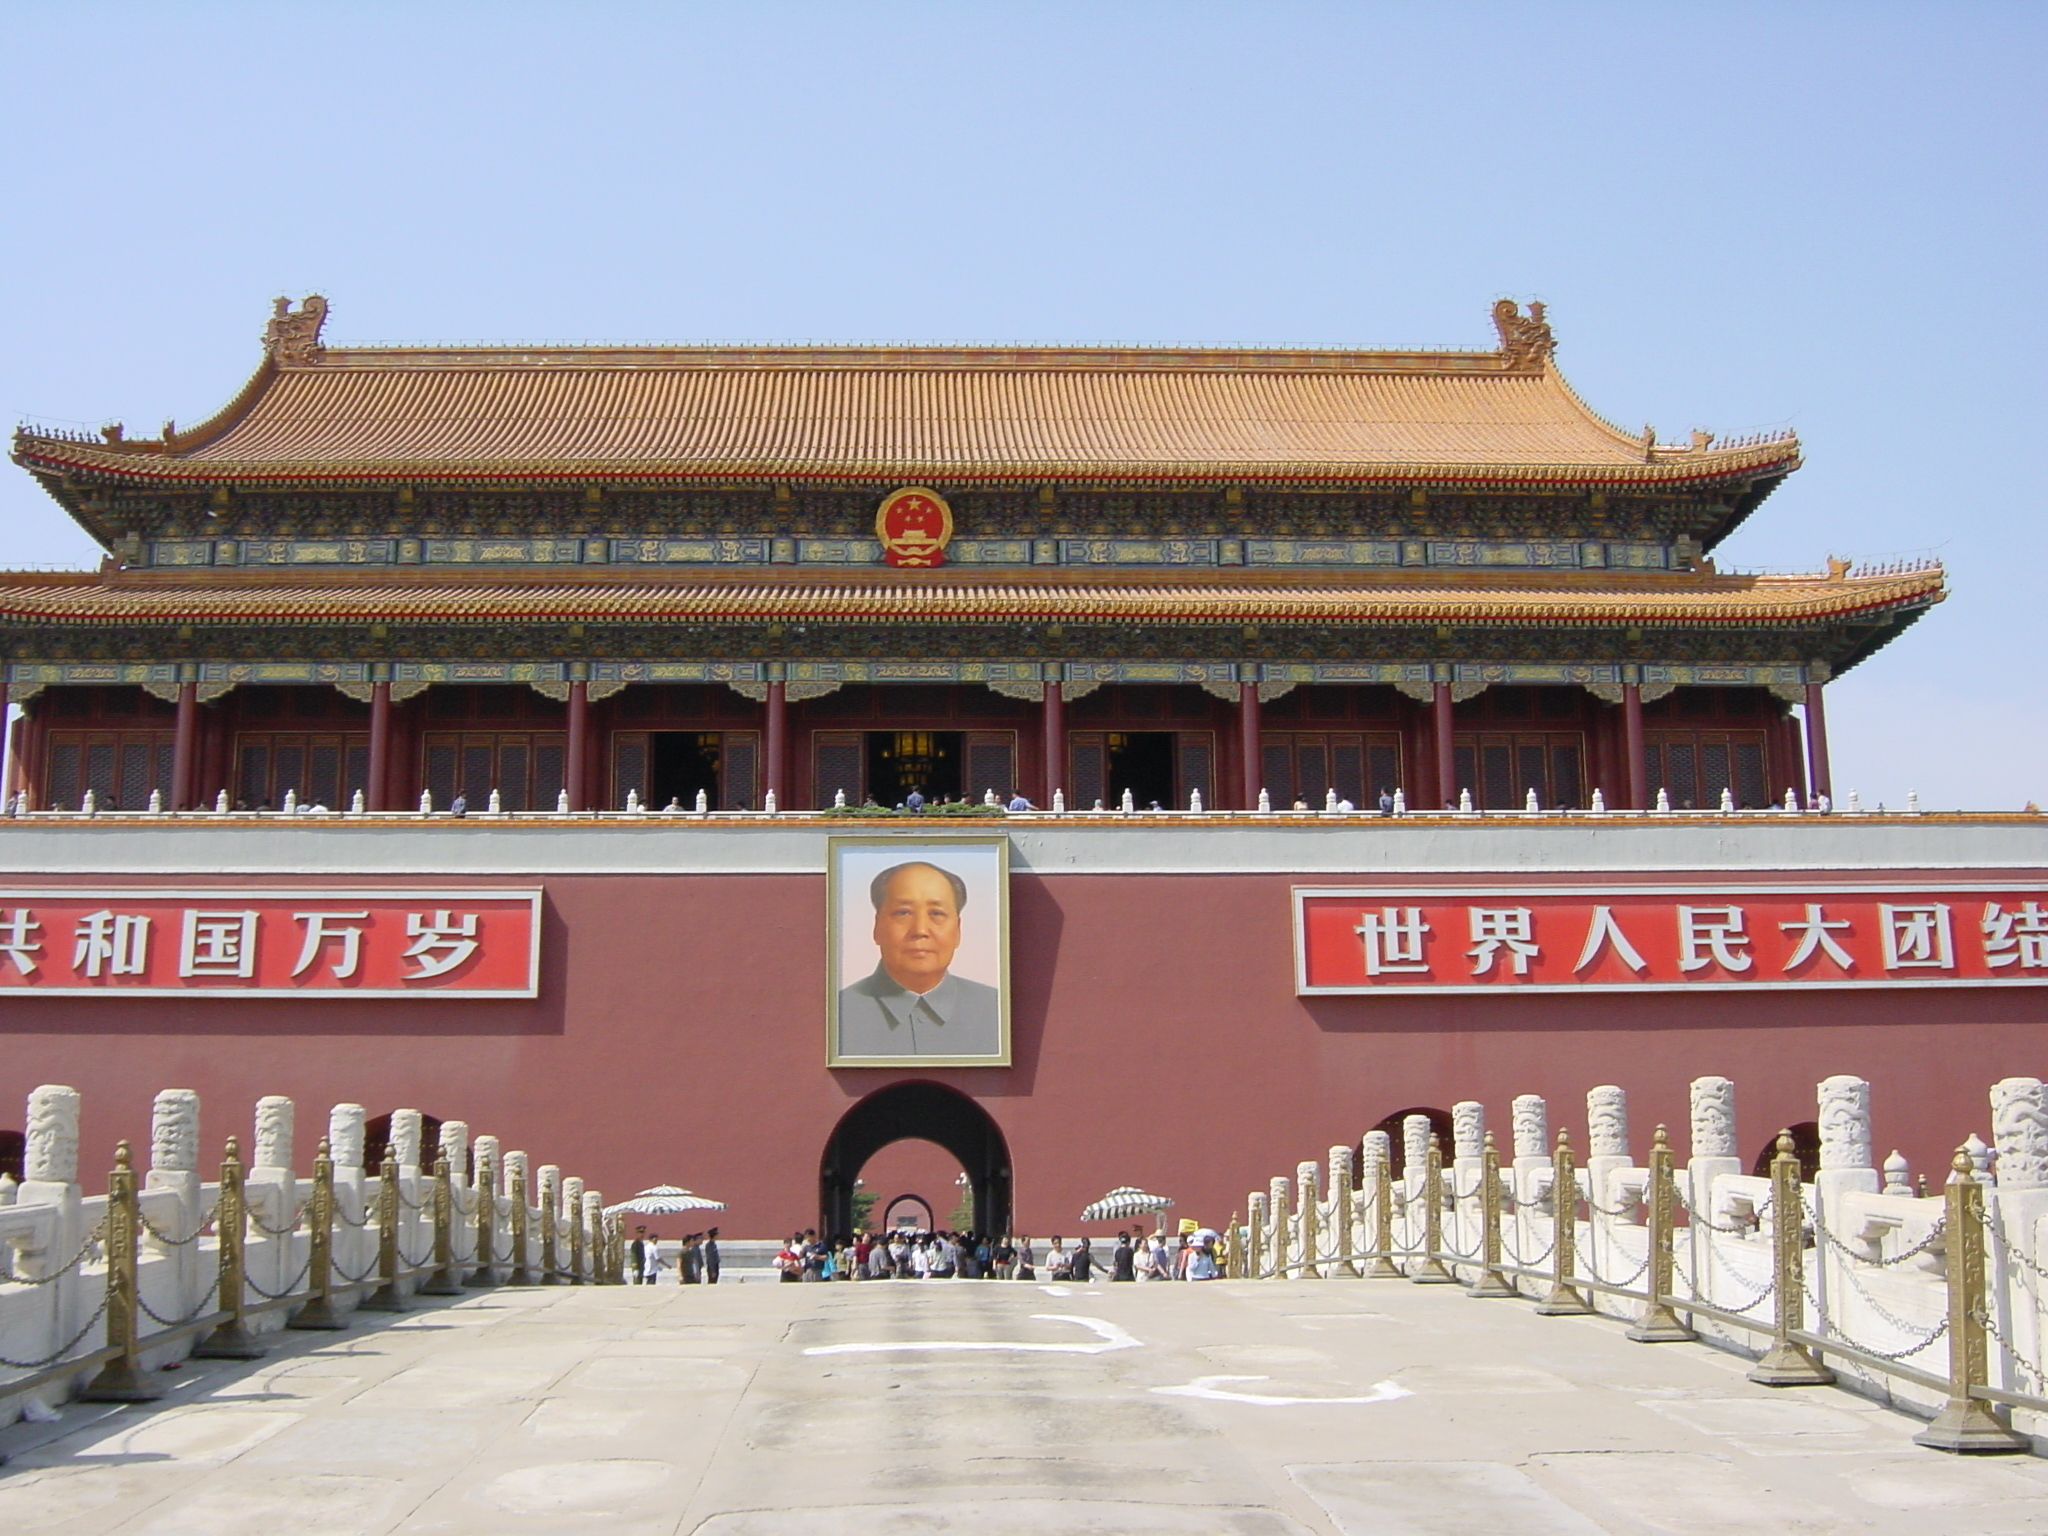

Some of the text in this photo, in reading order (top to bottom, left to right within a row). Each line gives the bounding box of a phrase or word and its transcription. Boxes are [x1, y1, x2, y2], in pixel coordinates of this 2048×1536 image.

[1354, 901, 2048, 976] 世界人民大团结
